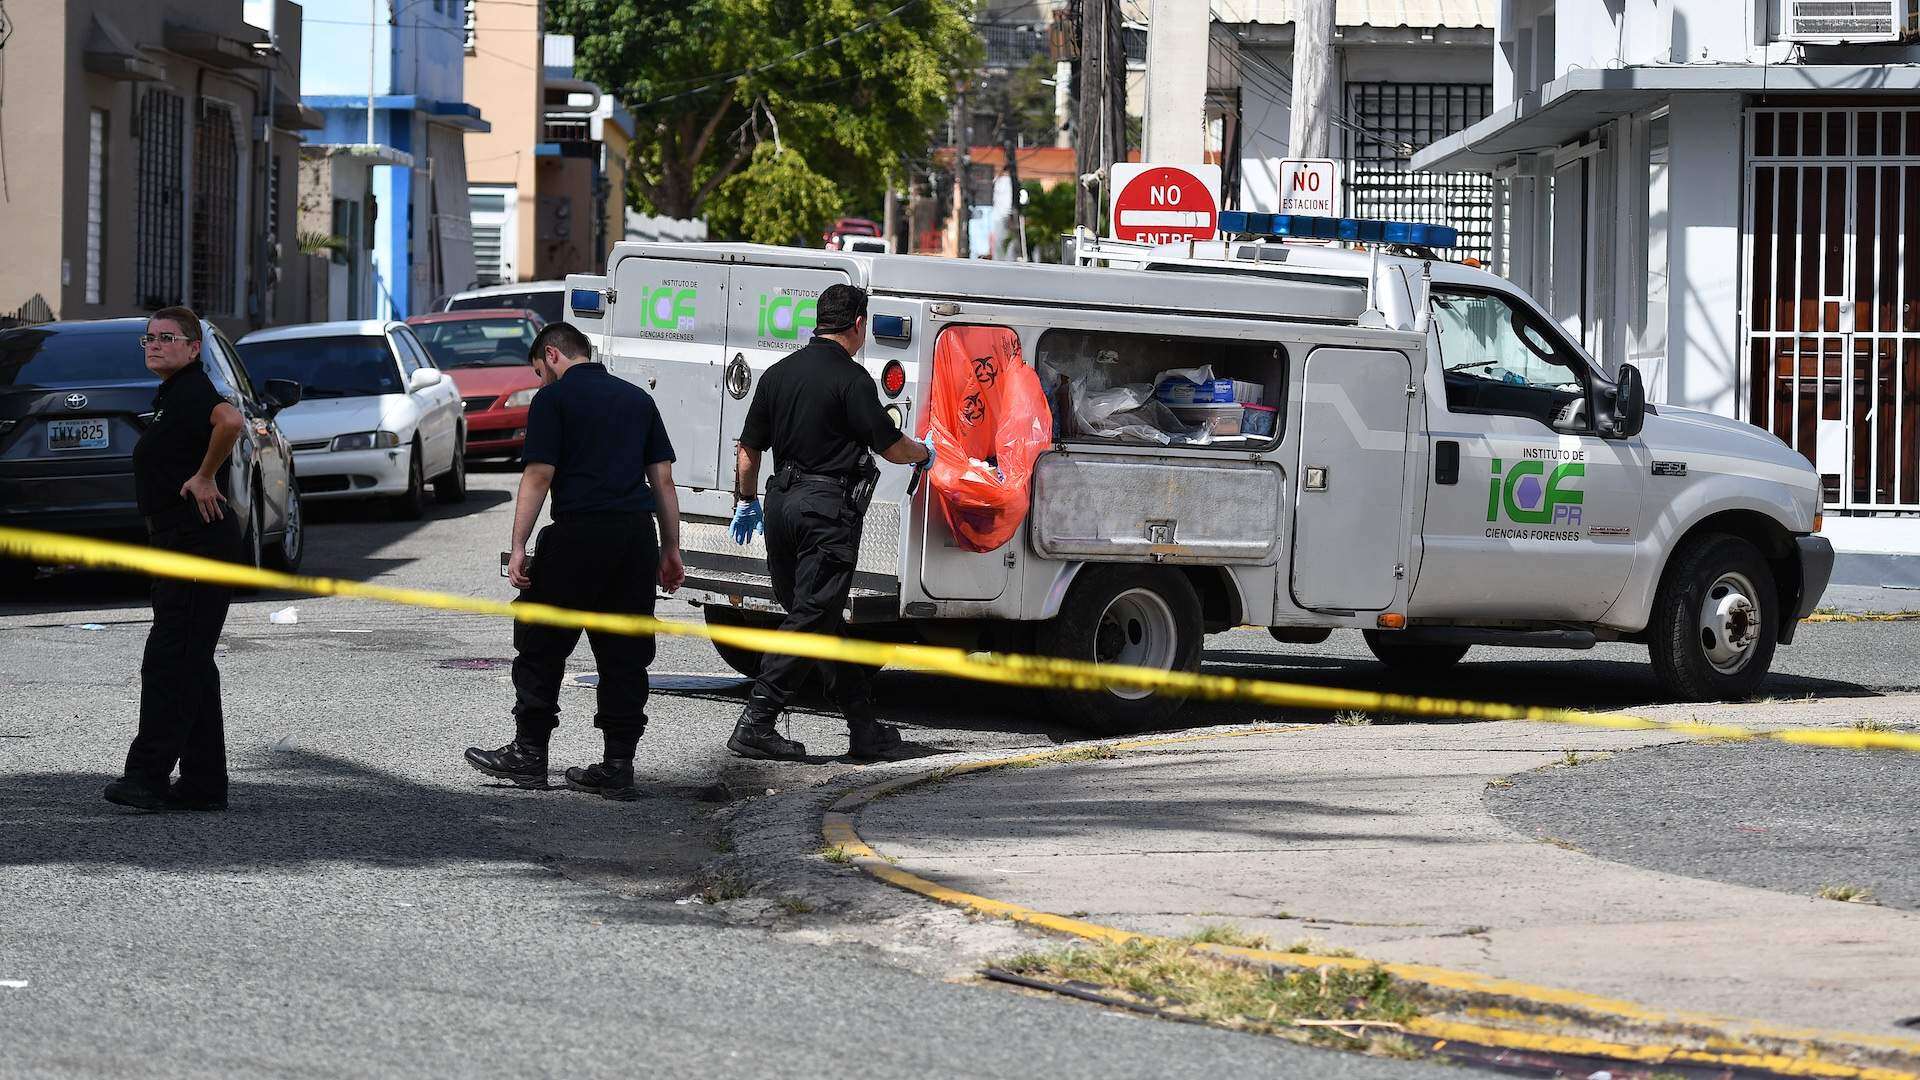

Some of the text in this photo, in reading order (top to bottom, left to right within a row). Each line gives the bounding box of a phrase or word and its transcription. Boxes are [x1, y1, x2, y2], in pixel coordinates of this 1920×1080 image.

[1294, 172, 1320, 191] NO
[1150, 184, 1182, 206] NO
[1283, 198, 1329, 210] ESTACIONE
[661, 279, 698, 288] INSTITUTO DE
[781, 288, 819, 298] INSTITUTO DE
[640, 330, 695, 341] CIENCIAS FORENSES
[757, 340, 784, 349] CIENCIAS
[81, 424, 104, 440] 825
[1523, 447, 1584, 460] INSTITUTO DE
[1485, 527, 1528, 540] CIENCIAS
[1530, 530, 1580, 542] FORENSES
